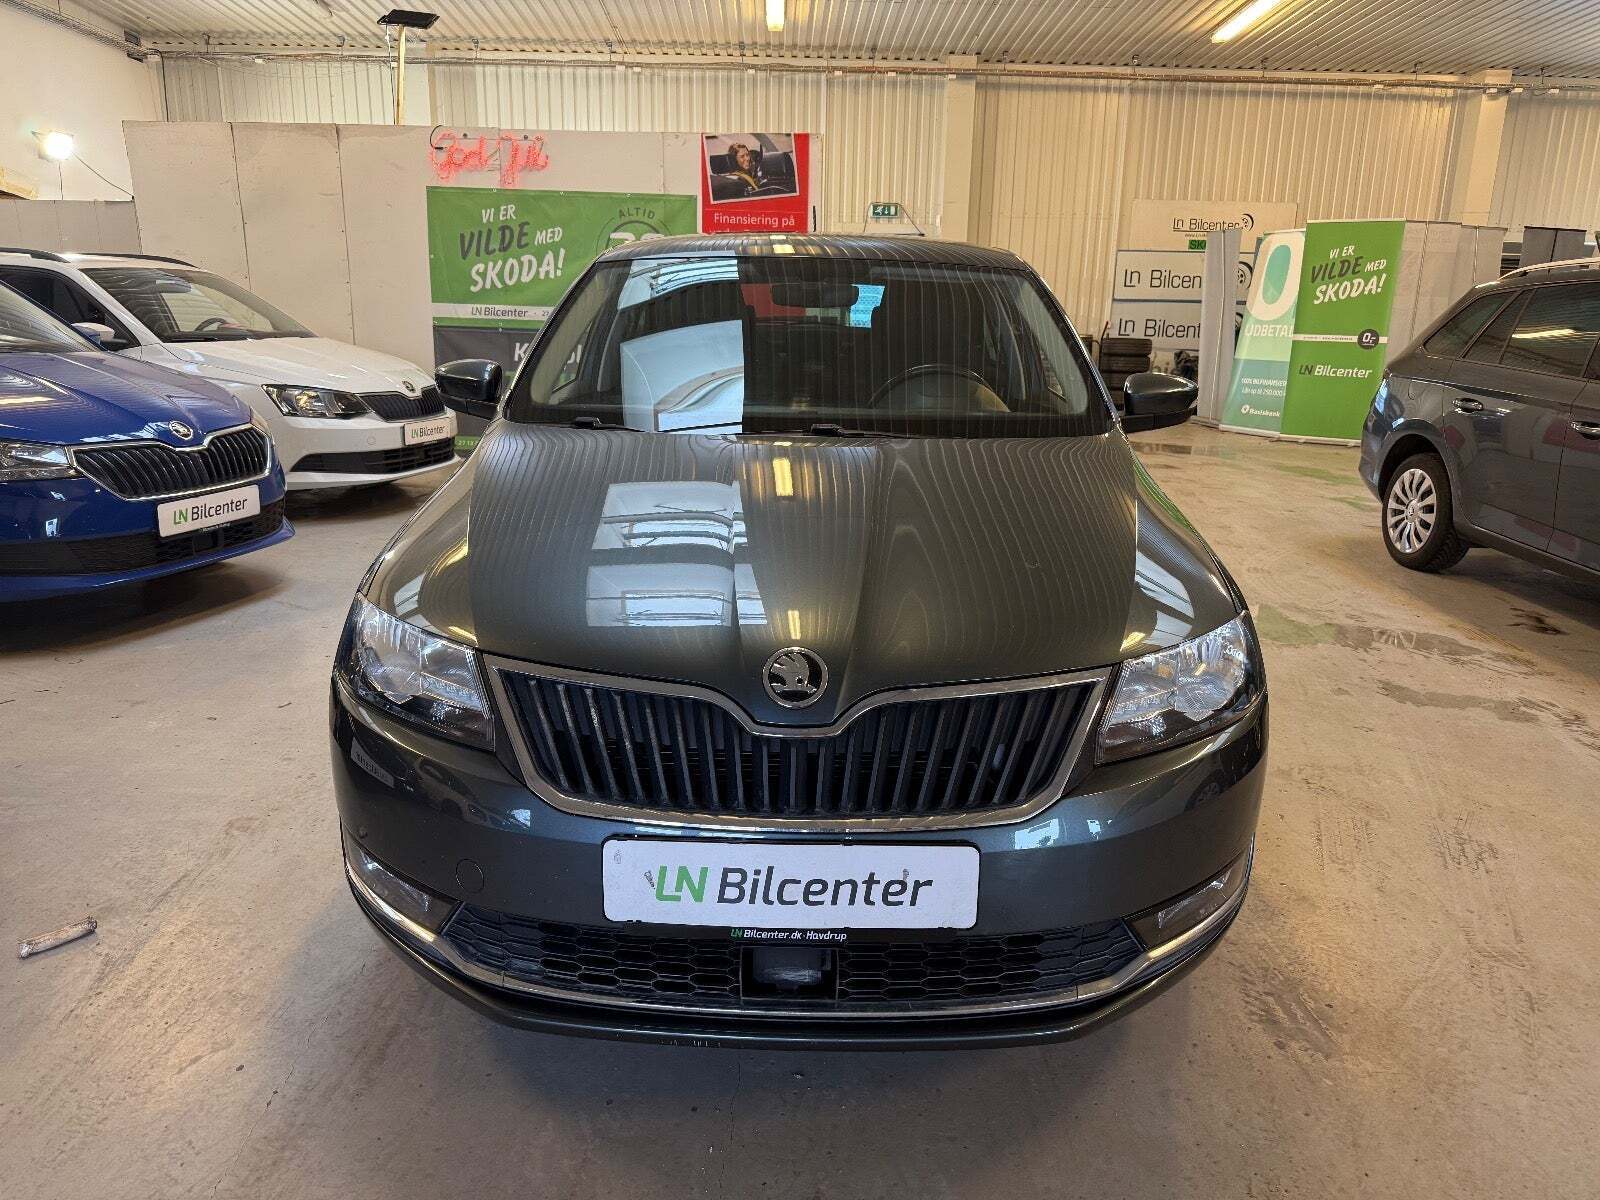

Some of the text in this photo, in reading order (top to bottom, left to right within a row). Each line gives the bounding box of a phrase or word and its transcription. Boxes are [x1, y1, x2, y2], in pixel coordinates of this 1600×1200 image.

[431, 132, 487, 180] God
[481, 204, 517, 224] VI ER
[618, 206, 656, 220] ALTID
[714, 212, 795, 228] Finansiering på
[459, 221, 563, 260] VILDE MED
[1329, 245, 1355, 259] VI ER
[469, 248, 566, 293] SKODA!
[1311, 255, 1387, 284] VILDE MED
[1313, 273, 1387, 305] SKODA!
[471, 306, 482, 316] LN
[483, 306, 529, 317] Bilcenter
[1299, 364, 1373, 379] LN Bilcenter
[419, 425, 445, 438] Bilcenter
[173, 498, 247, 525] LN Bilcenter
[655, 866, 933, 907] LN Bilcenter
[731, 929, 742, 938] LN
[806, 931, 847, 942] Havdrup
